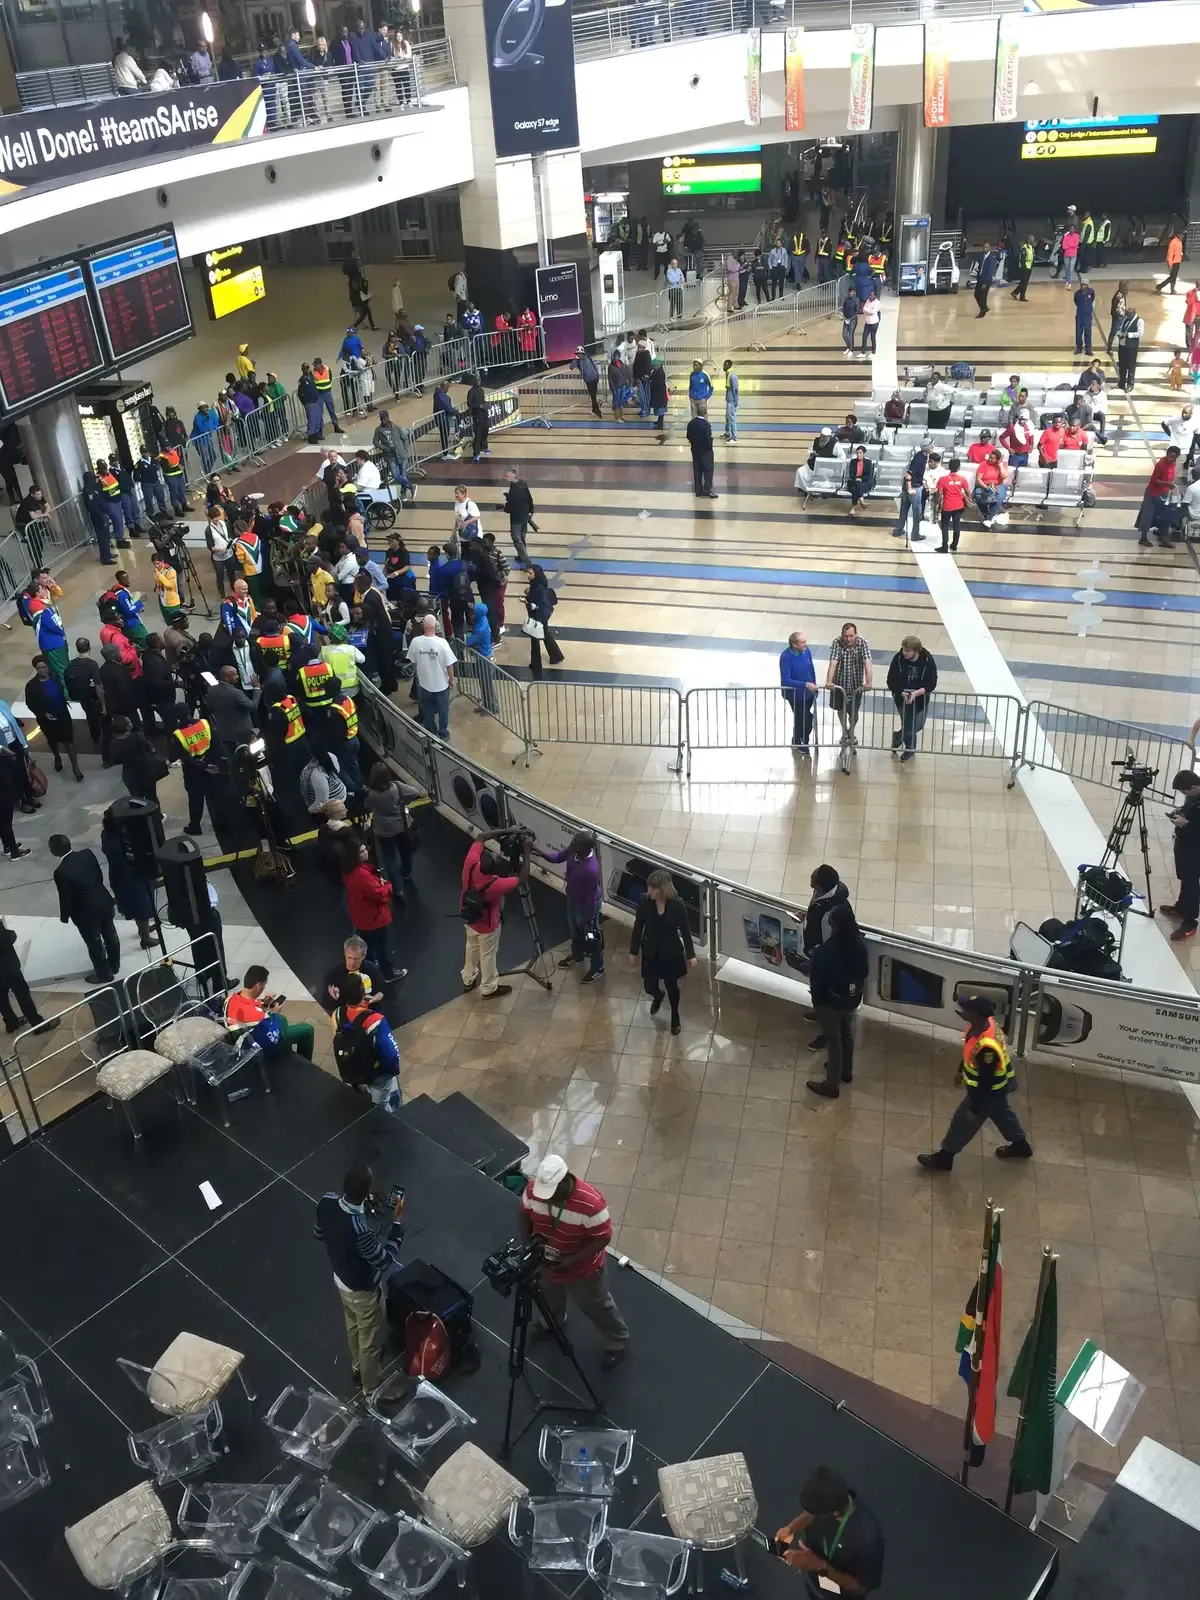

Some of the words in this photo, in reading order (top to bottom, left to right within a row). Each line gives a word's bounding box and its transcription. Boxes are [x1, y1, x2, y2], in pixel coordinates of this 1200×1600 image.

[1007, 45, 1015, 105] RECREATION
[860, 56, 869, 116] RECREATION
[514, 120, 538, 130] Galaxy
[537, 117, 545, 127] S7
[545, 118, 560, 127] edge
[0, 133, 37, 173] Well
[36, 120, 99, 162] Done!
[100, 101, 219, 149] #teamSArise
[540, 293, 559, 303] Limo
[306, 674, 330, 689] POLICE
[186, 729, 209, 747] POLICE
[1155, 1008, 1200, 1022] SAMSUN
[1119, 1024, 1140, 1033] Your
[1141, 1029, 1163, 1038] own
[1096, 1052, 1126, 1064] Galaxy
[1126, 1058, 1137, 1066] S7
[1136, 1060, 1155, 1070] edge
[1162, 1065, 1184, 1075] Gear
[1184, 1069, 1196, 1077] VR
